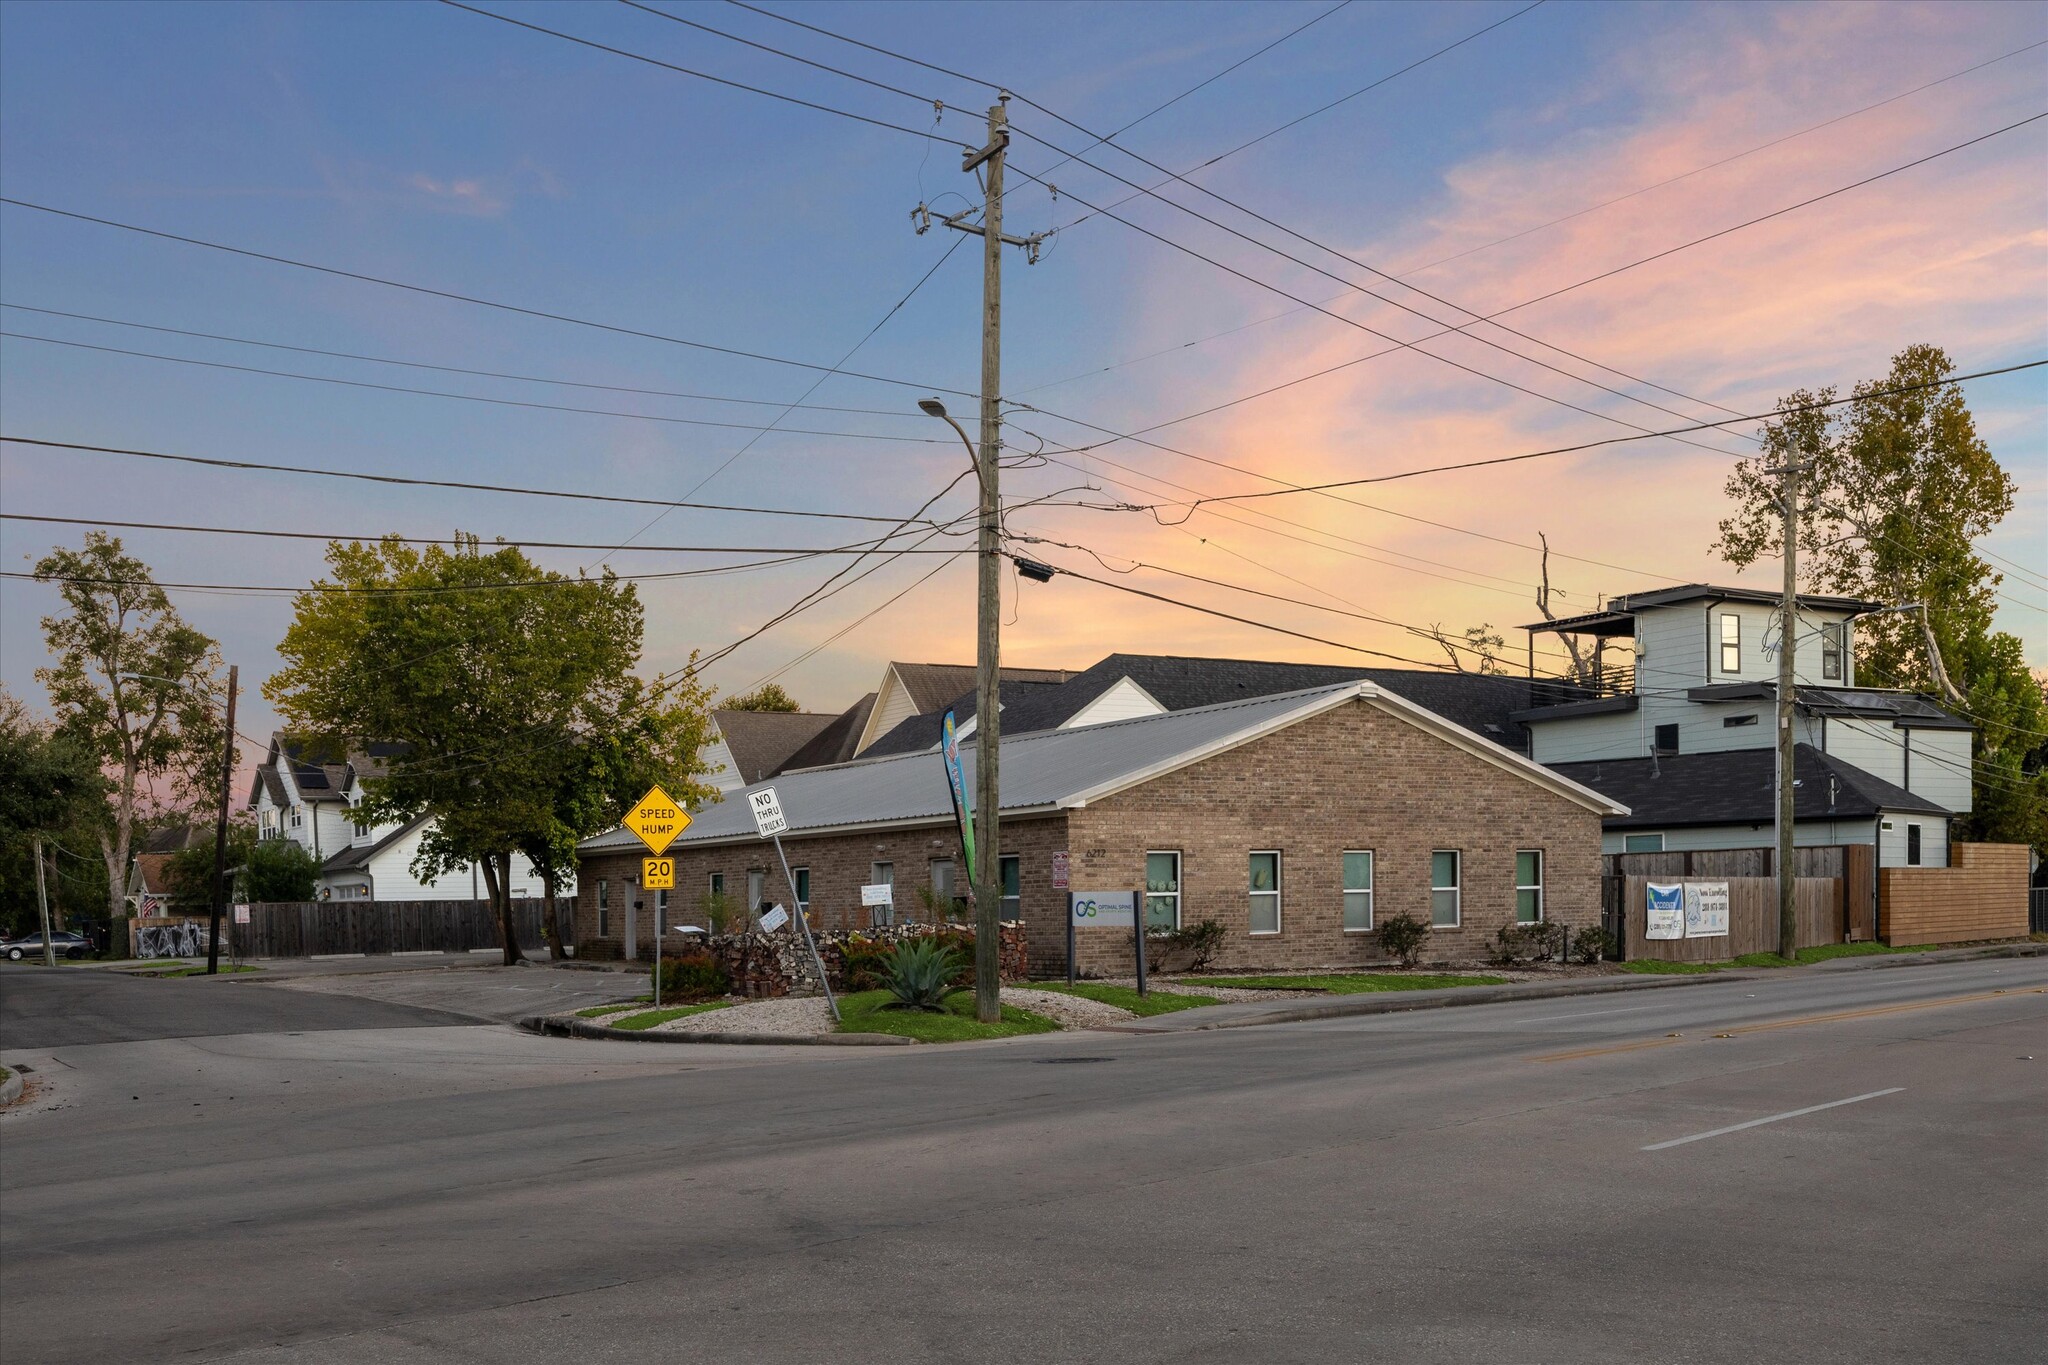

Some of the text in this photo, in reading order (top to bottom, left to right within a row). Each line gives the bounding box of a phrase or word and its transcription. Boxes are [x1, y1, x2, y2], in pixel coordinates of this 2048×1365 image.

[755, 793, 771, 807] NO
[640, 809, 675, 818] SPEED
[757, 806, 779, 820] THRU
[642, 825, 673, 834] HUMP
[760, 818, 784, 832] TRUCKS
[1086, 849, 1106, 858] 6212
[648, 862, 670, 876] 20
